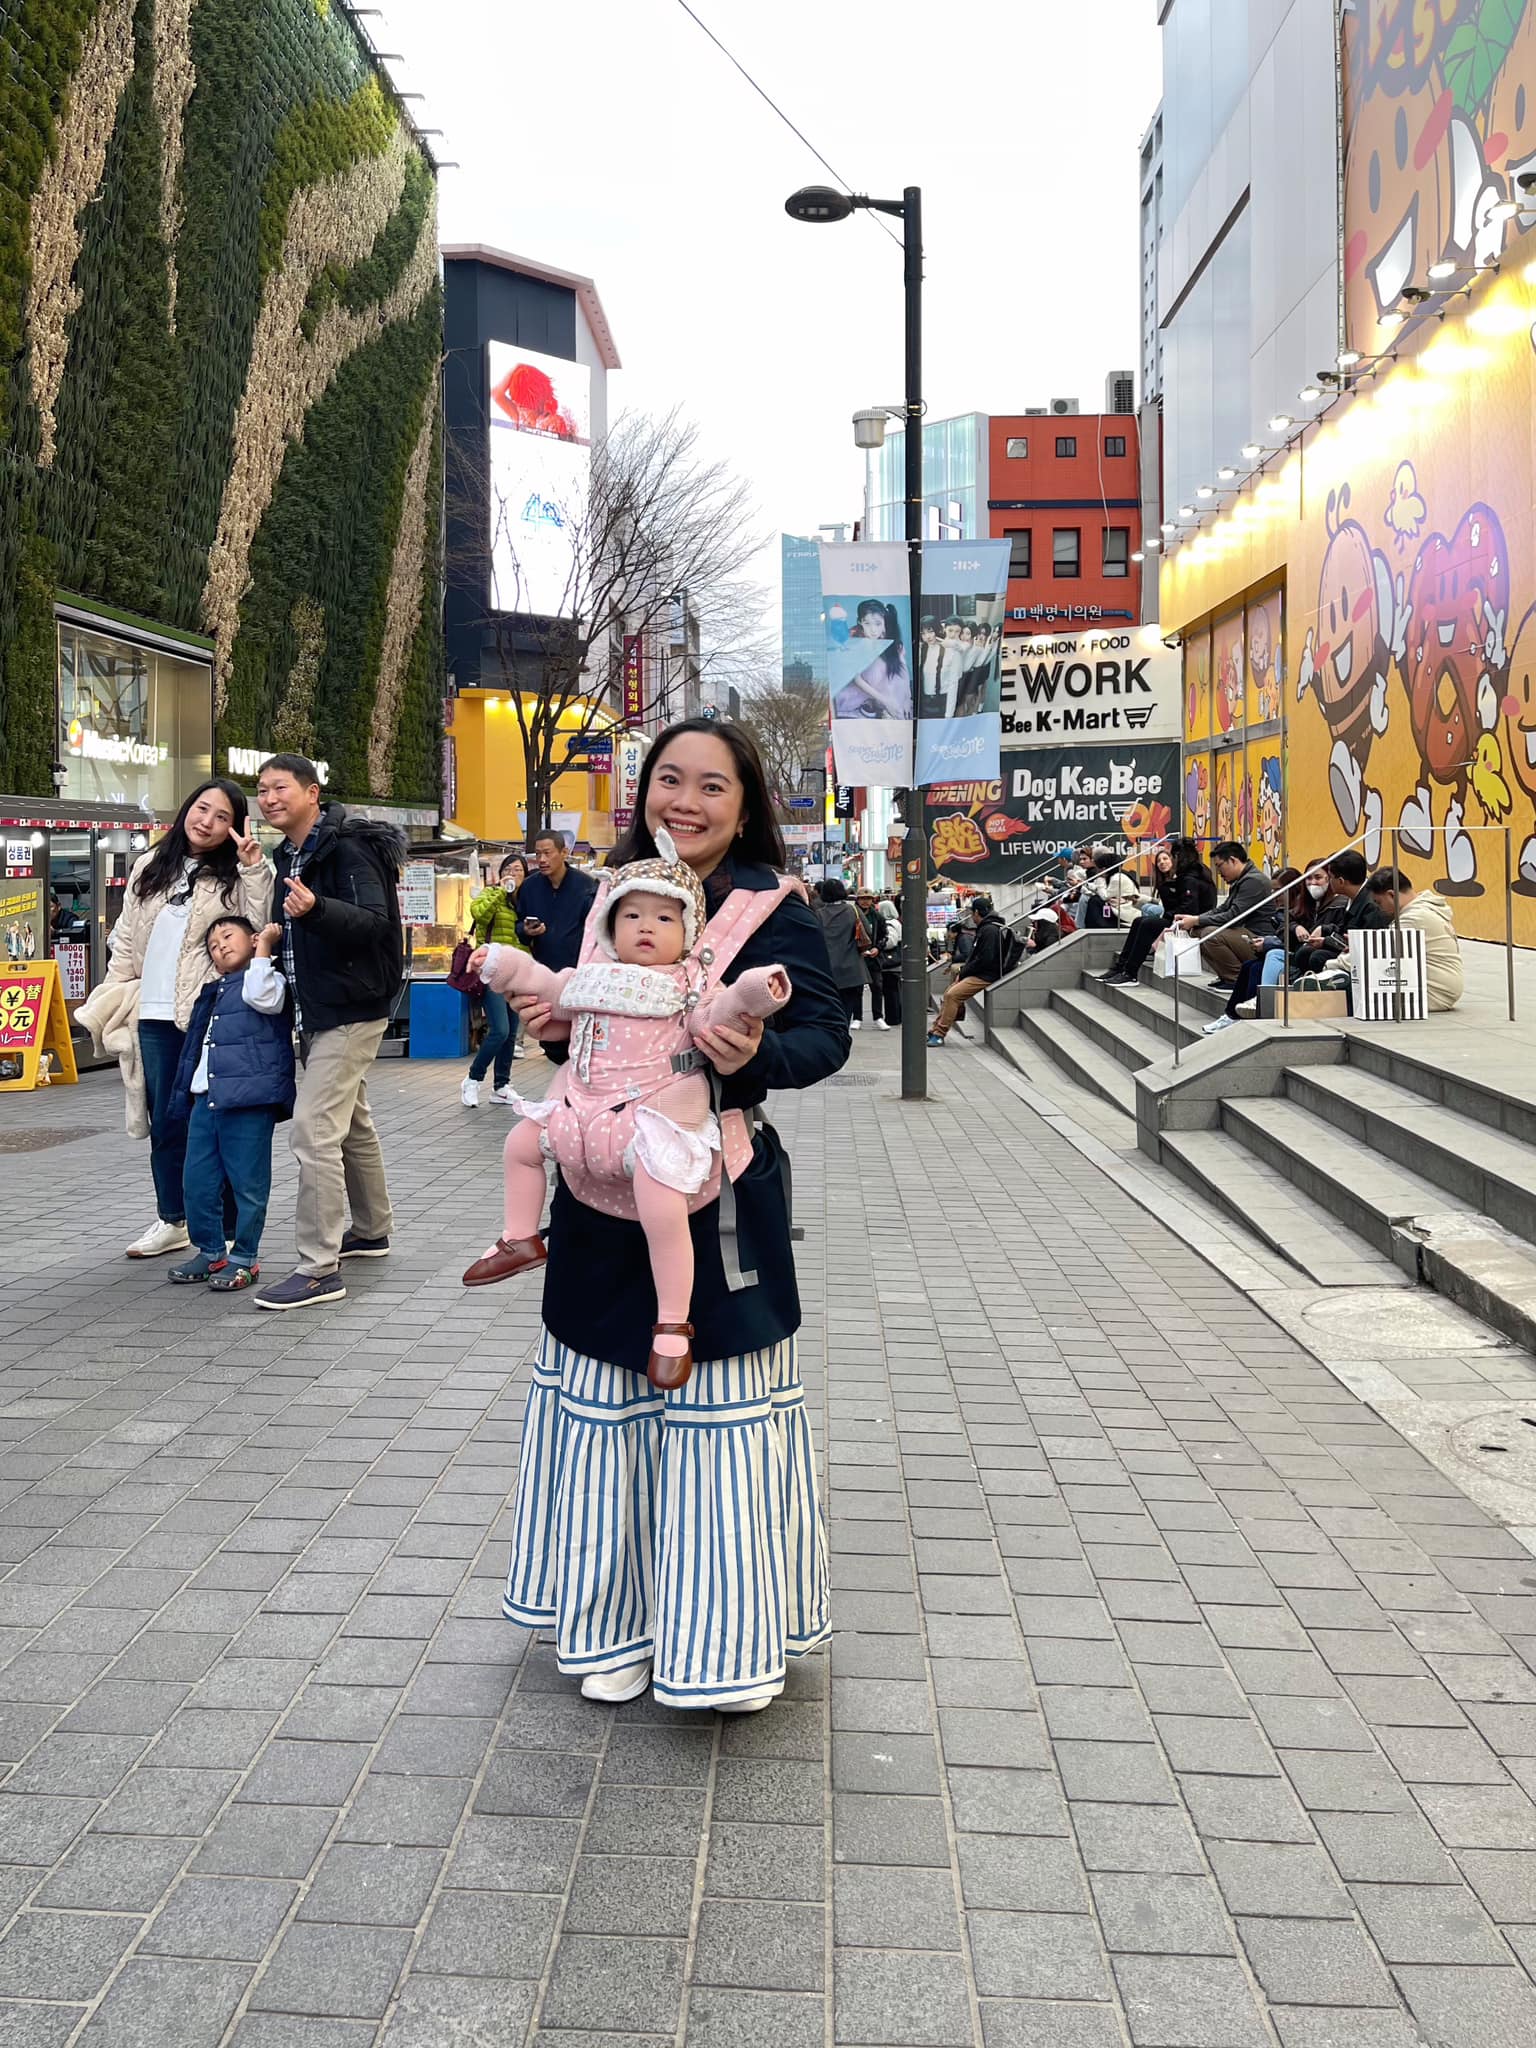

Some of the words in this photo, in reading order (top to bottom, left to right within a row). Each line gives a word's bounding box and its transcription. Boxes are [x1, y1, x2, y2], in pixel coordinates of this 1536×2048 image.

[1020, 641, 1077, 656] FASHION
[1091, 636, 1130, 652] FOOD
[1036, 708, 1120, 731] K-Mart
[932, 780, 1003, 802] OPENING
[1012, 769, 1057, 800] Dog
[1028, 799, 1108, 821] K-Mart
[938, 816, 977, 839] BIG
[8, 845, 31, 860] 상품권
[932, 832, 984, 856] SALE
[26, 984, 42, 1000] 替
[13, 1010, 30, 1027] 元
